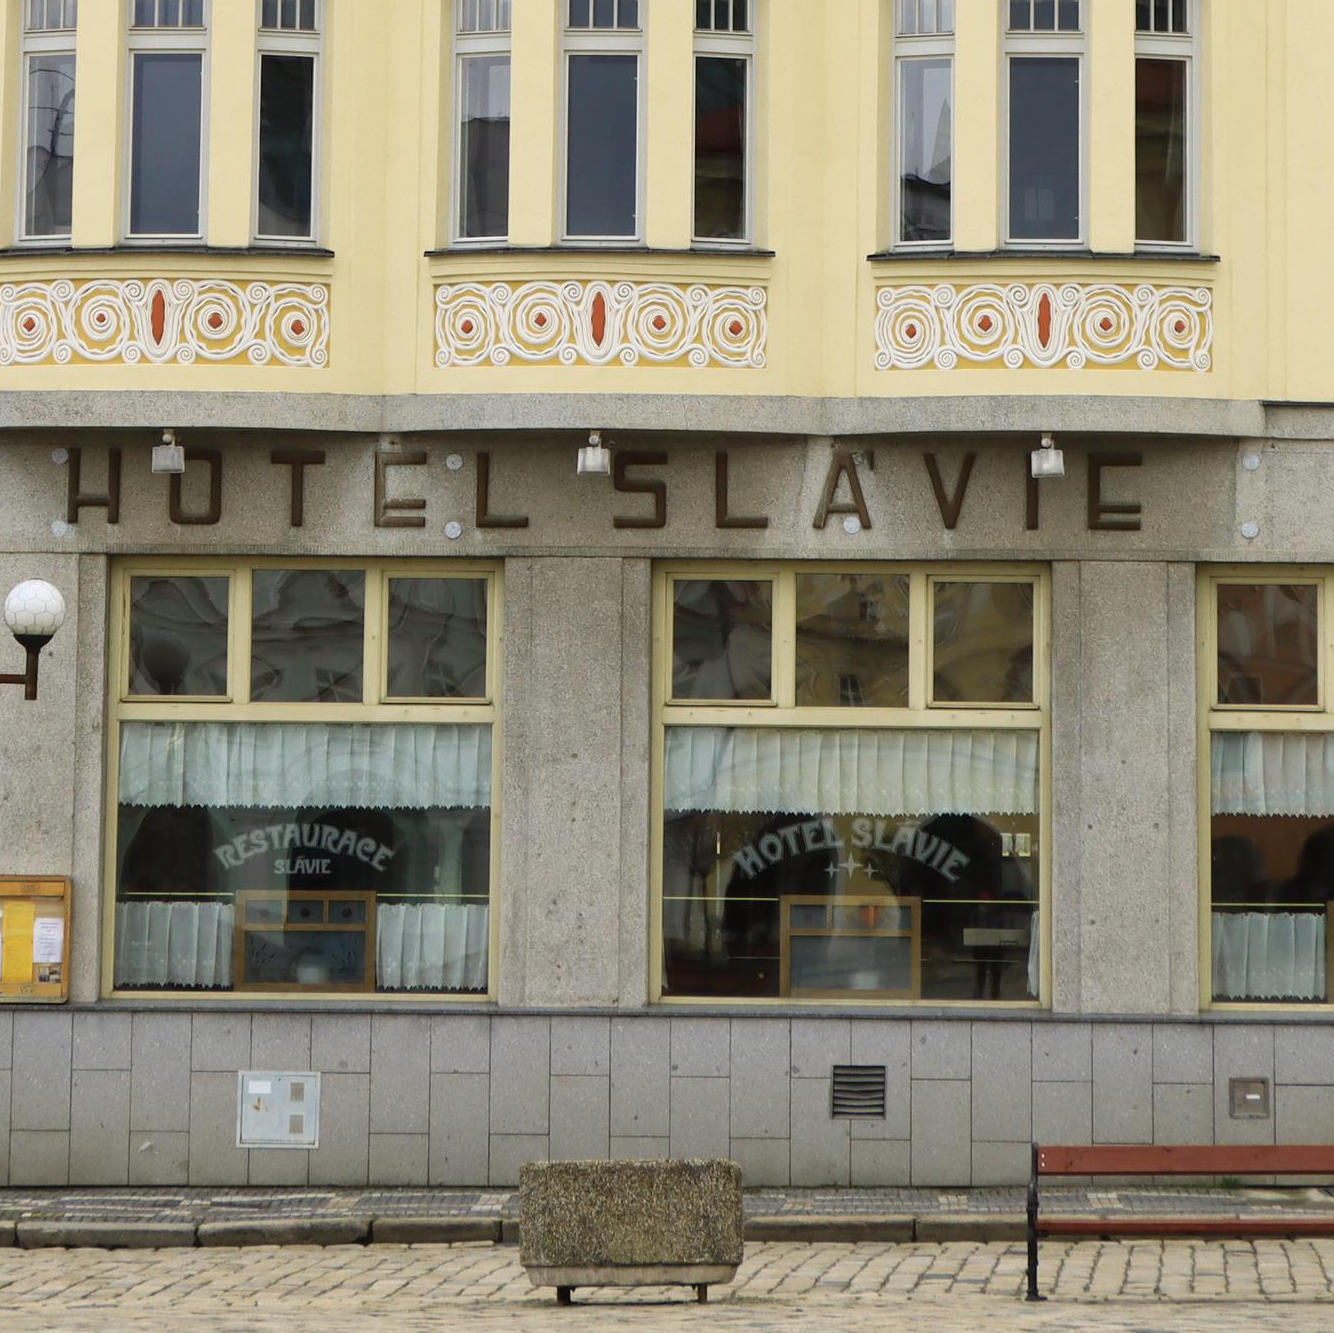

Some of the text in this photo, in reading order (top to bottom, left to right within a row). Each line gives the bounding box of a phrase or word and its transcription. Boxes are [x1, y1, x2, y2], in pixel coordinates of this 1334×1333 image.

[67, 447, 1142, 530] HOTEL SLÁVIE
[213, 823, 395, 872] RESTAURACE
[274, 856, 331, 874] SLÁVIE
[733, 818, 845, 879] HOTEL
